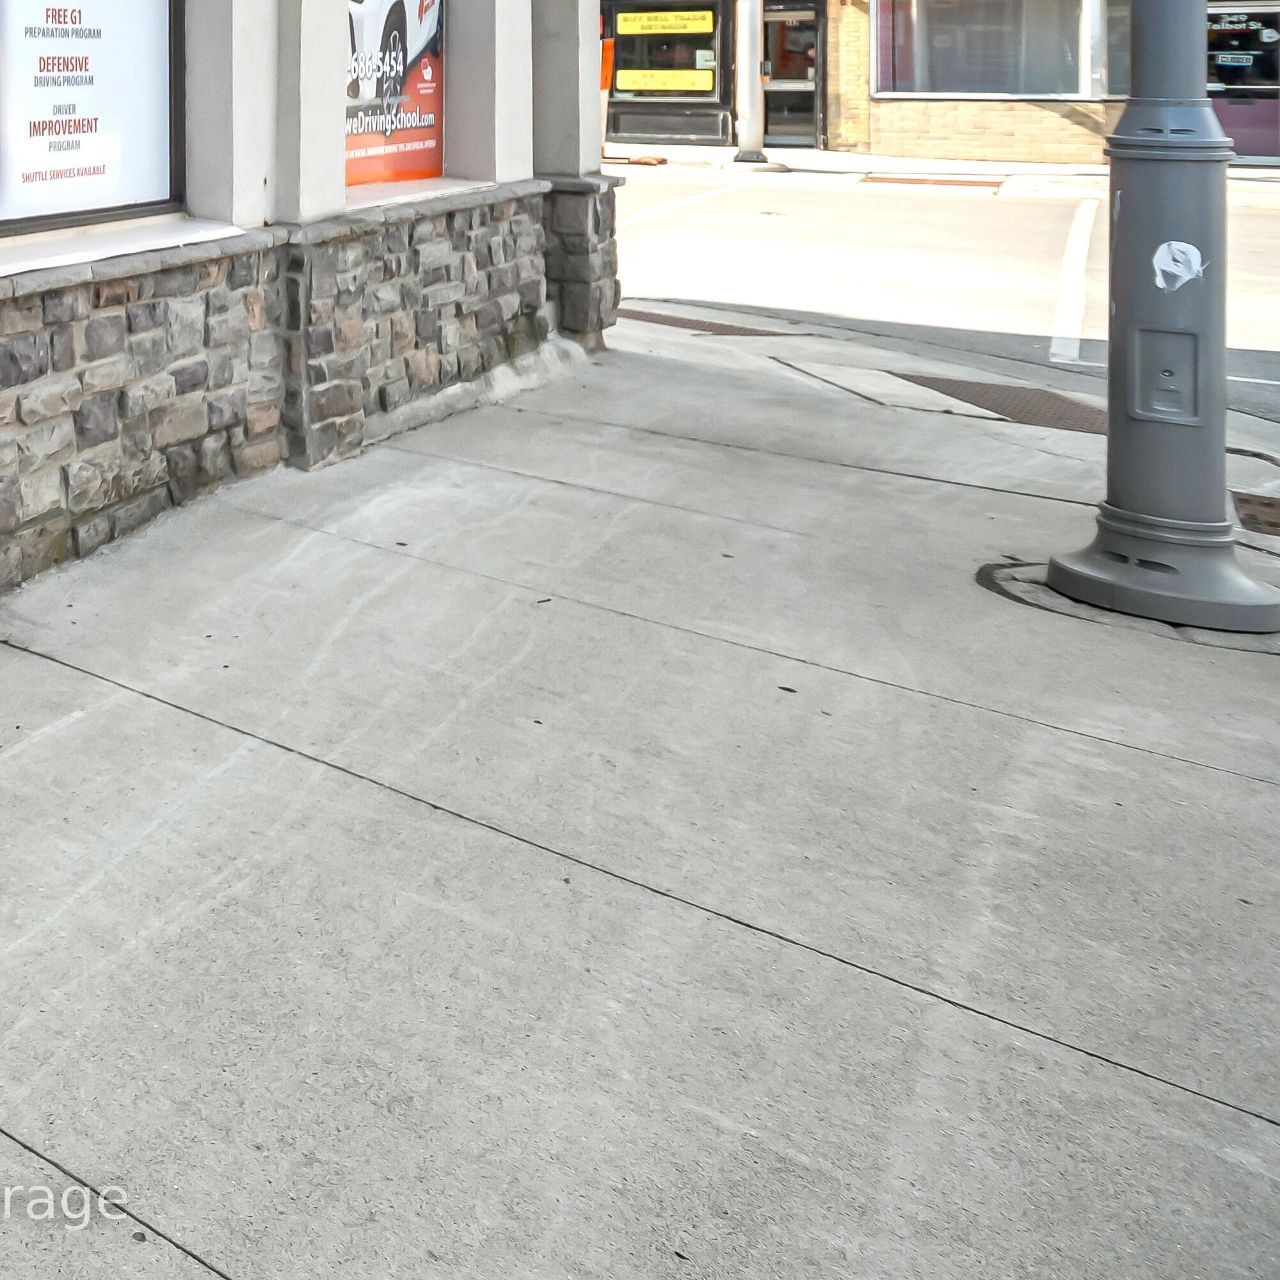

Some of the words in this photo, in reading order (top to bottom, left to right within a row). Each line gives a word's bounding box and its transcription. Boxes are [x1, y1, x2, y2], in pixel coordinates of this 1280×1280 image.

[45, 8, 69, 25] FREE
[70, 8, 83, 25] G1
[24, 26, 70, 39] PREPARATION
[71, 28, 102, 39] PROGRAM
[39, 55, 90, 73] DEFENSIVE
[33, 75, 62, 88] DRIVING
[62, 74, 94, 87] PROGRAM
[52, 103, 77, 116] DRIVER
[29, 117, 99, 138] IMPROVEMENT
[48, 139, 81, 153] PROGRAM
[21, 170, 49, 184] SHUTTLE
[49, 167, 77, 181] SERVICES
[76, 164, 106, 177] AVAILABLE
